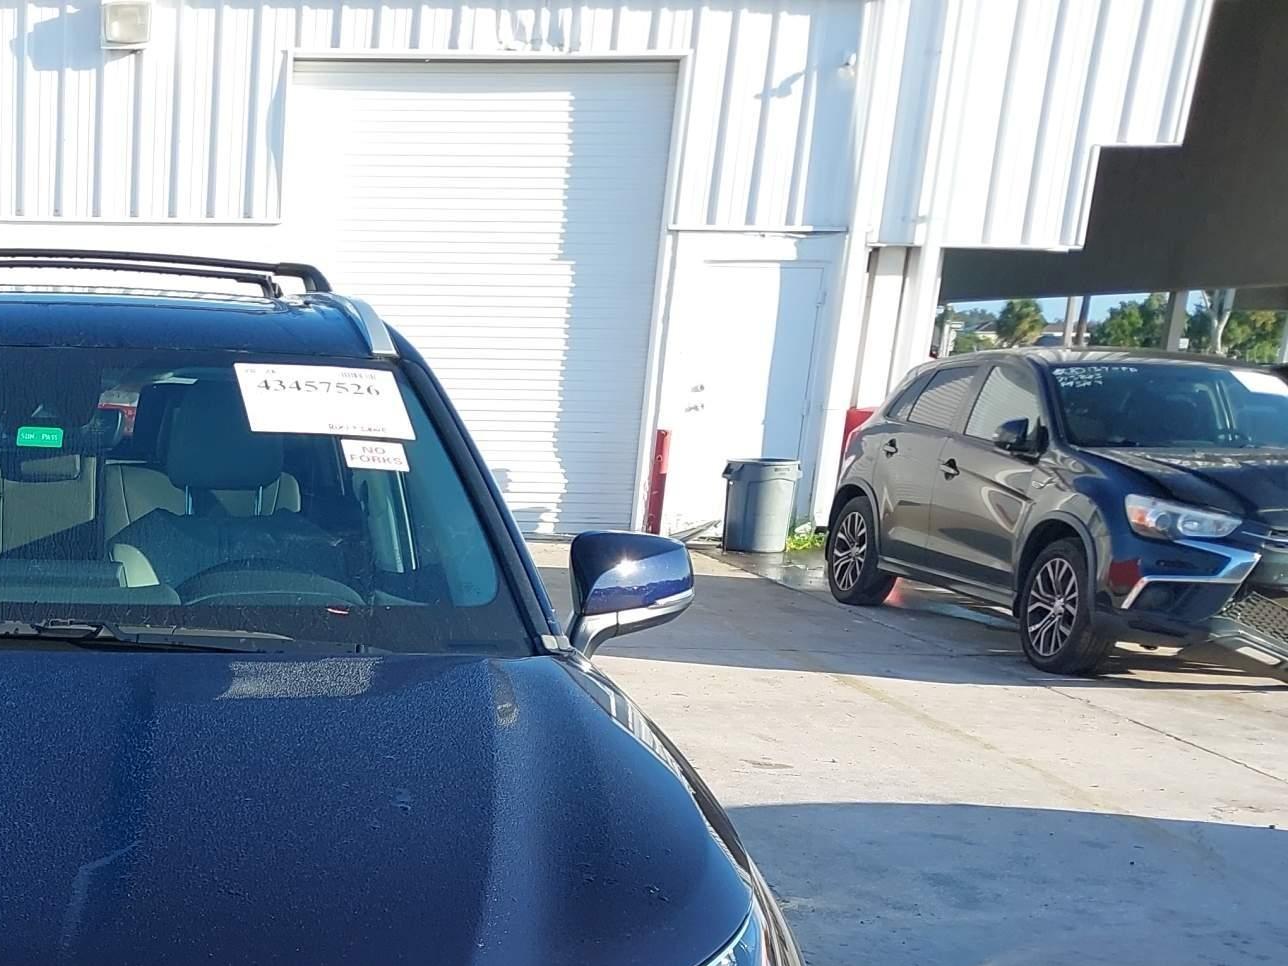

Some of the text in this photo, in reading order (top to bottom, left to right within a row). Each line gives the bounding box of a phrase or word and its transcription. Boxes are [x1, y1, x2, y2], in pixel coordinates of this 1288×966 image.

[257, 379, 380, 396] 43457526
[362, 446, 386, 455] NO
[350, 454, 403, 466] FORKS
